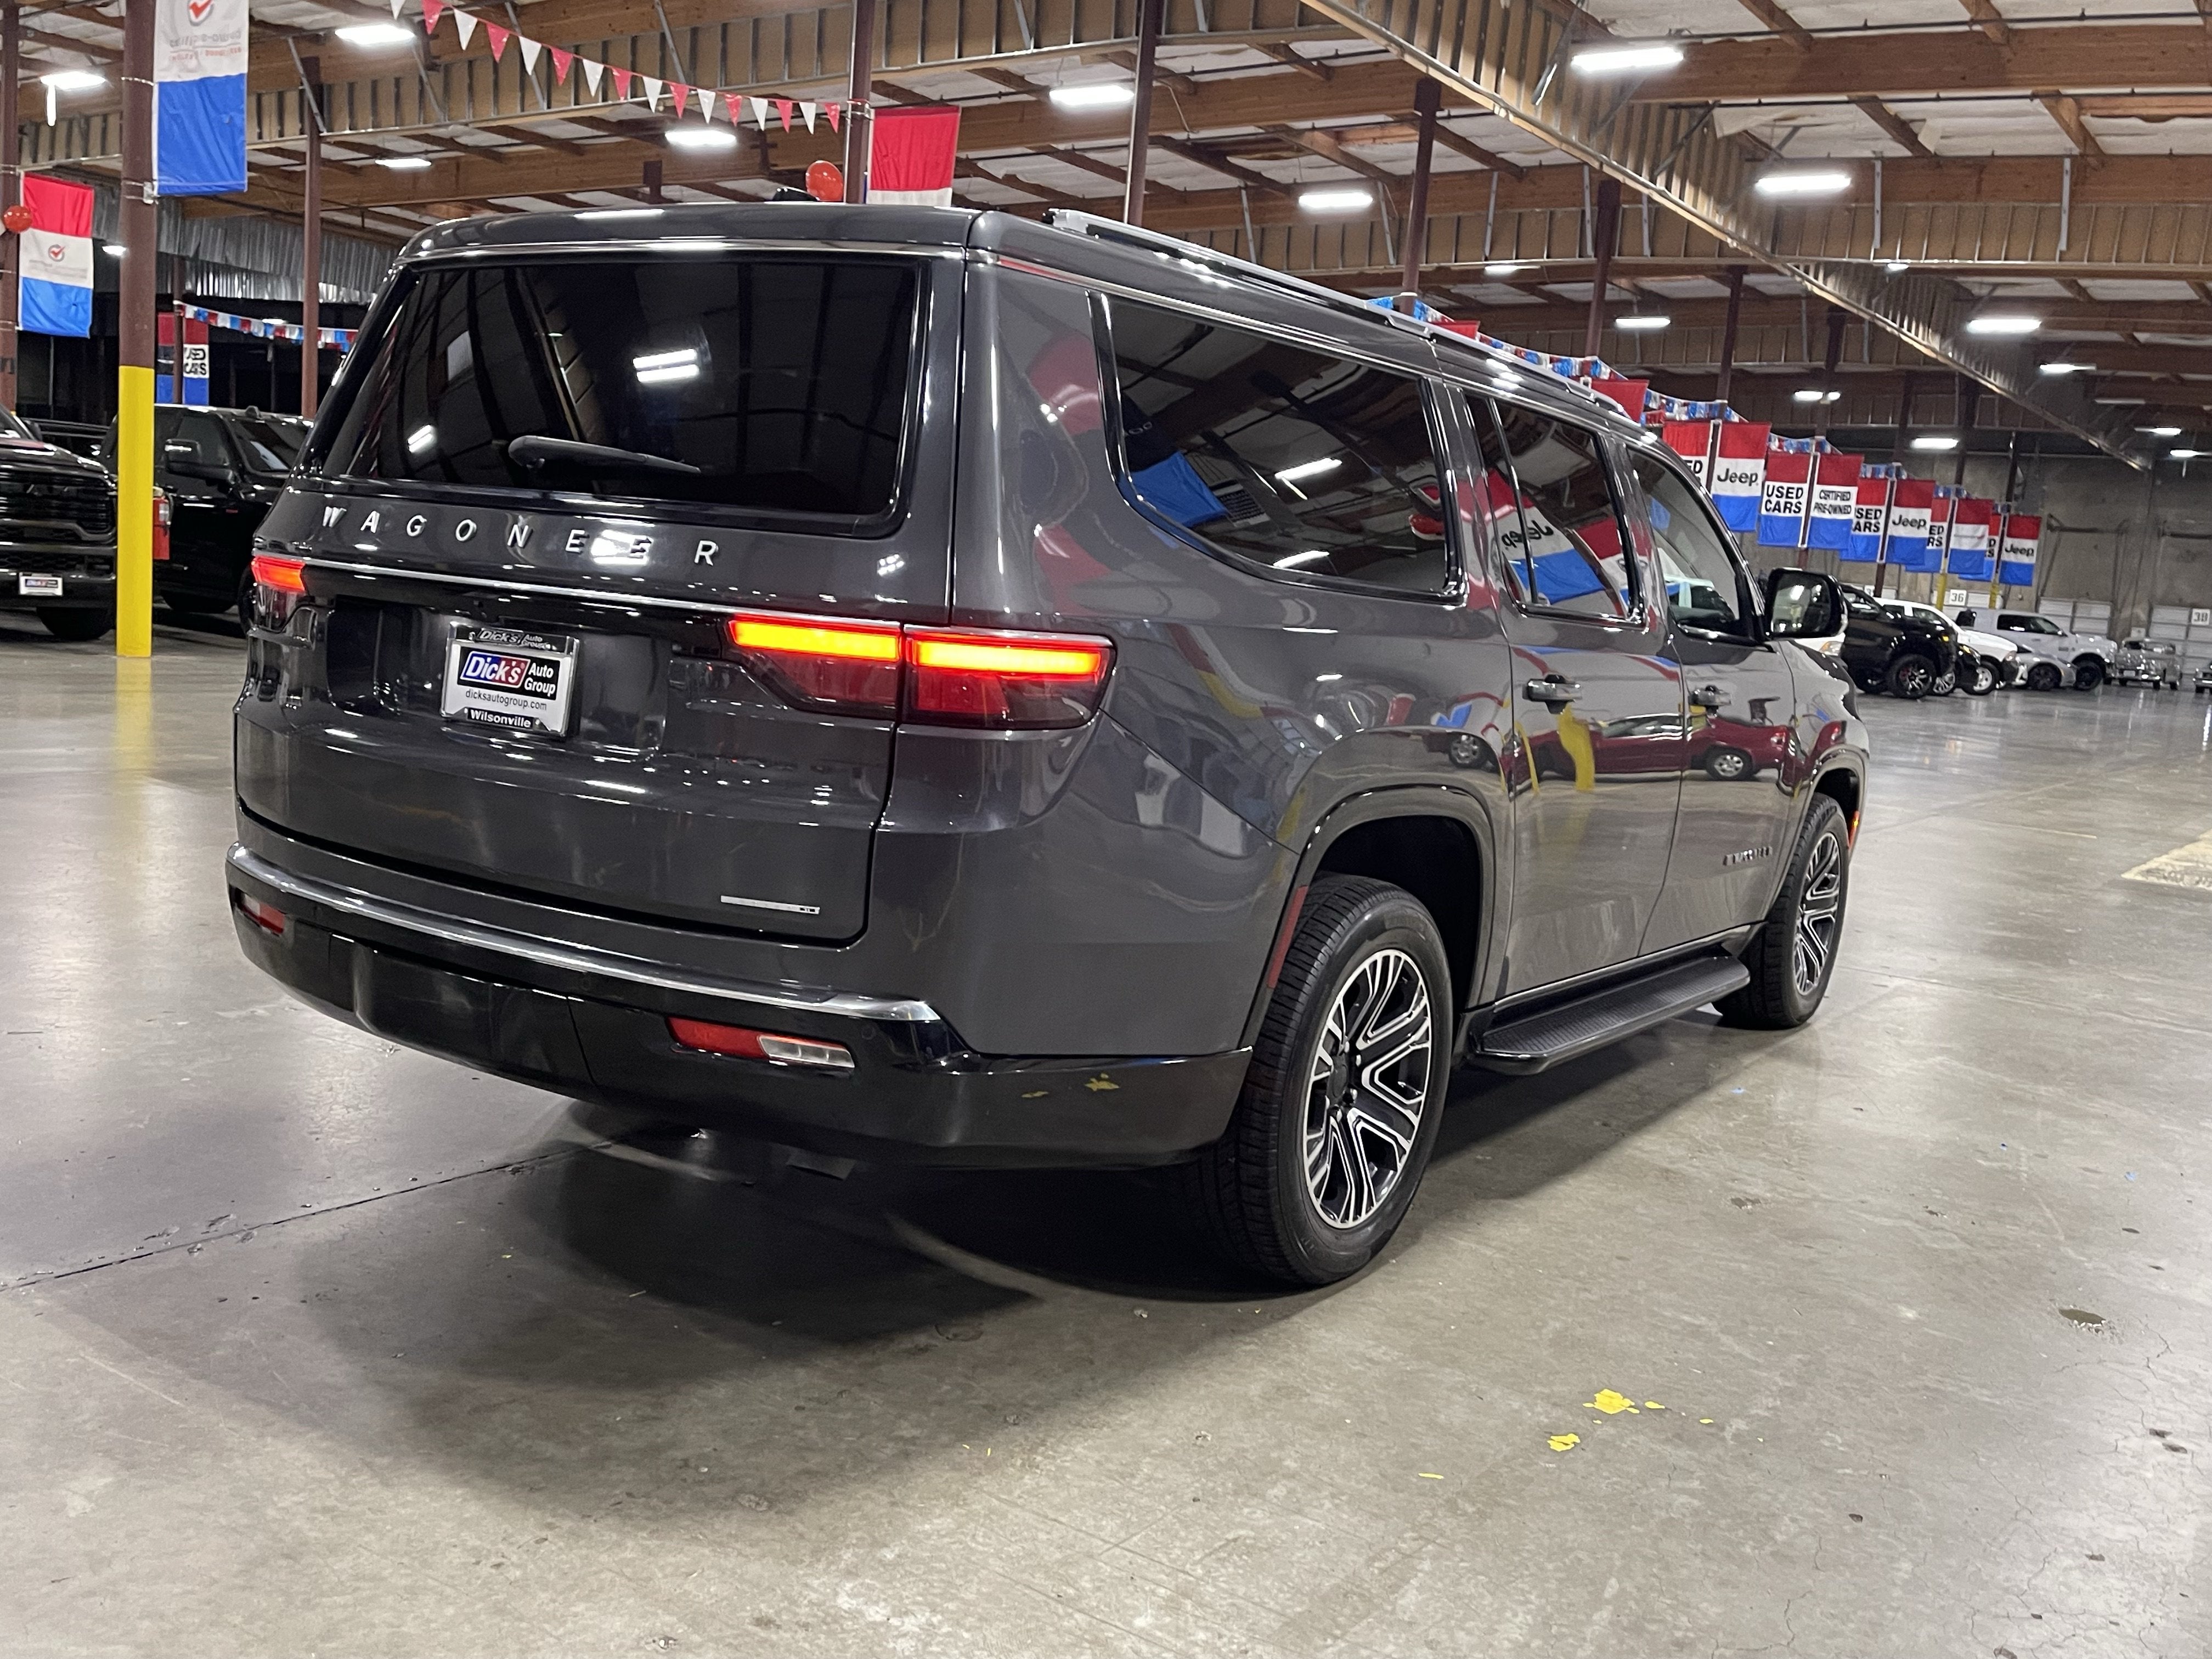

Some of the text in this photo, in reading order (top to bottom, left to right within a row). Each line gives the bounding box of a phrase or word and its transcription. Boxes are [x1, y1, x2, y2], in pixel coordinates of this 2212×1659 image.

[1717, 467, 1758, 487] Jeep
[1767, 484, 1804, 499] USED
[1764, 499, 1802, 514] CARS
[1855, 507, 1882, 520] SED
[1853, 521, 1881, 533] ARS
[1892, 515, 1927, 531] Jeep
[1929, 525, 1944, 535] ED
[322, 506, 719, 566] WAGONEER
[1927, 537, 1943, 547] RS
[2005, 543, 2035, 557] Jeep
[1951, 592, 1965, 602] 36
[479, 630, 543, 644] Dick's Auto
[465, 656, 554, 684] Dick's Auto
[524, 677, 556, 697] Group
[465, 689, 548, 712] dicksautogroup.com
[470, 709, 532, 728] Wilsonville
